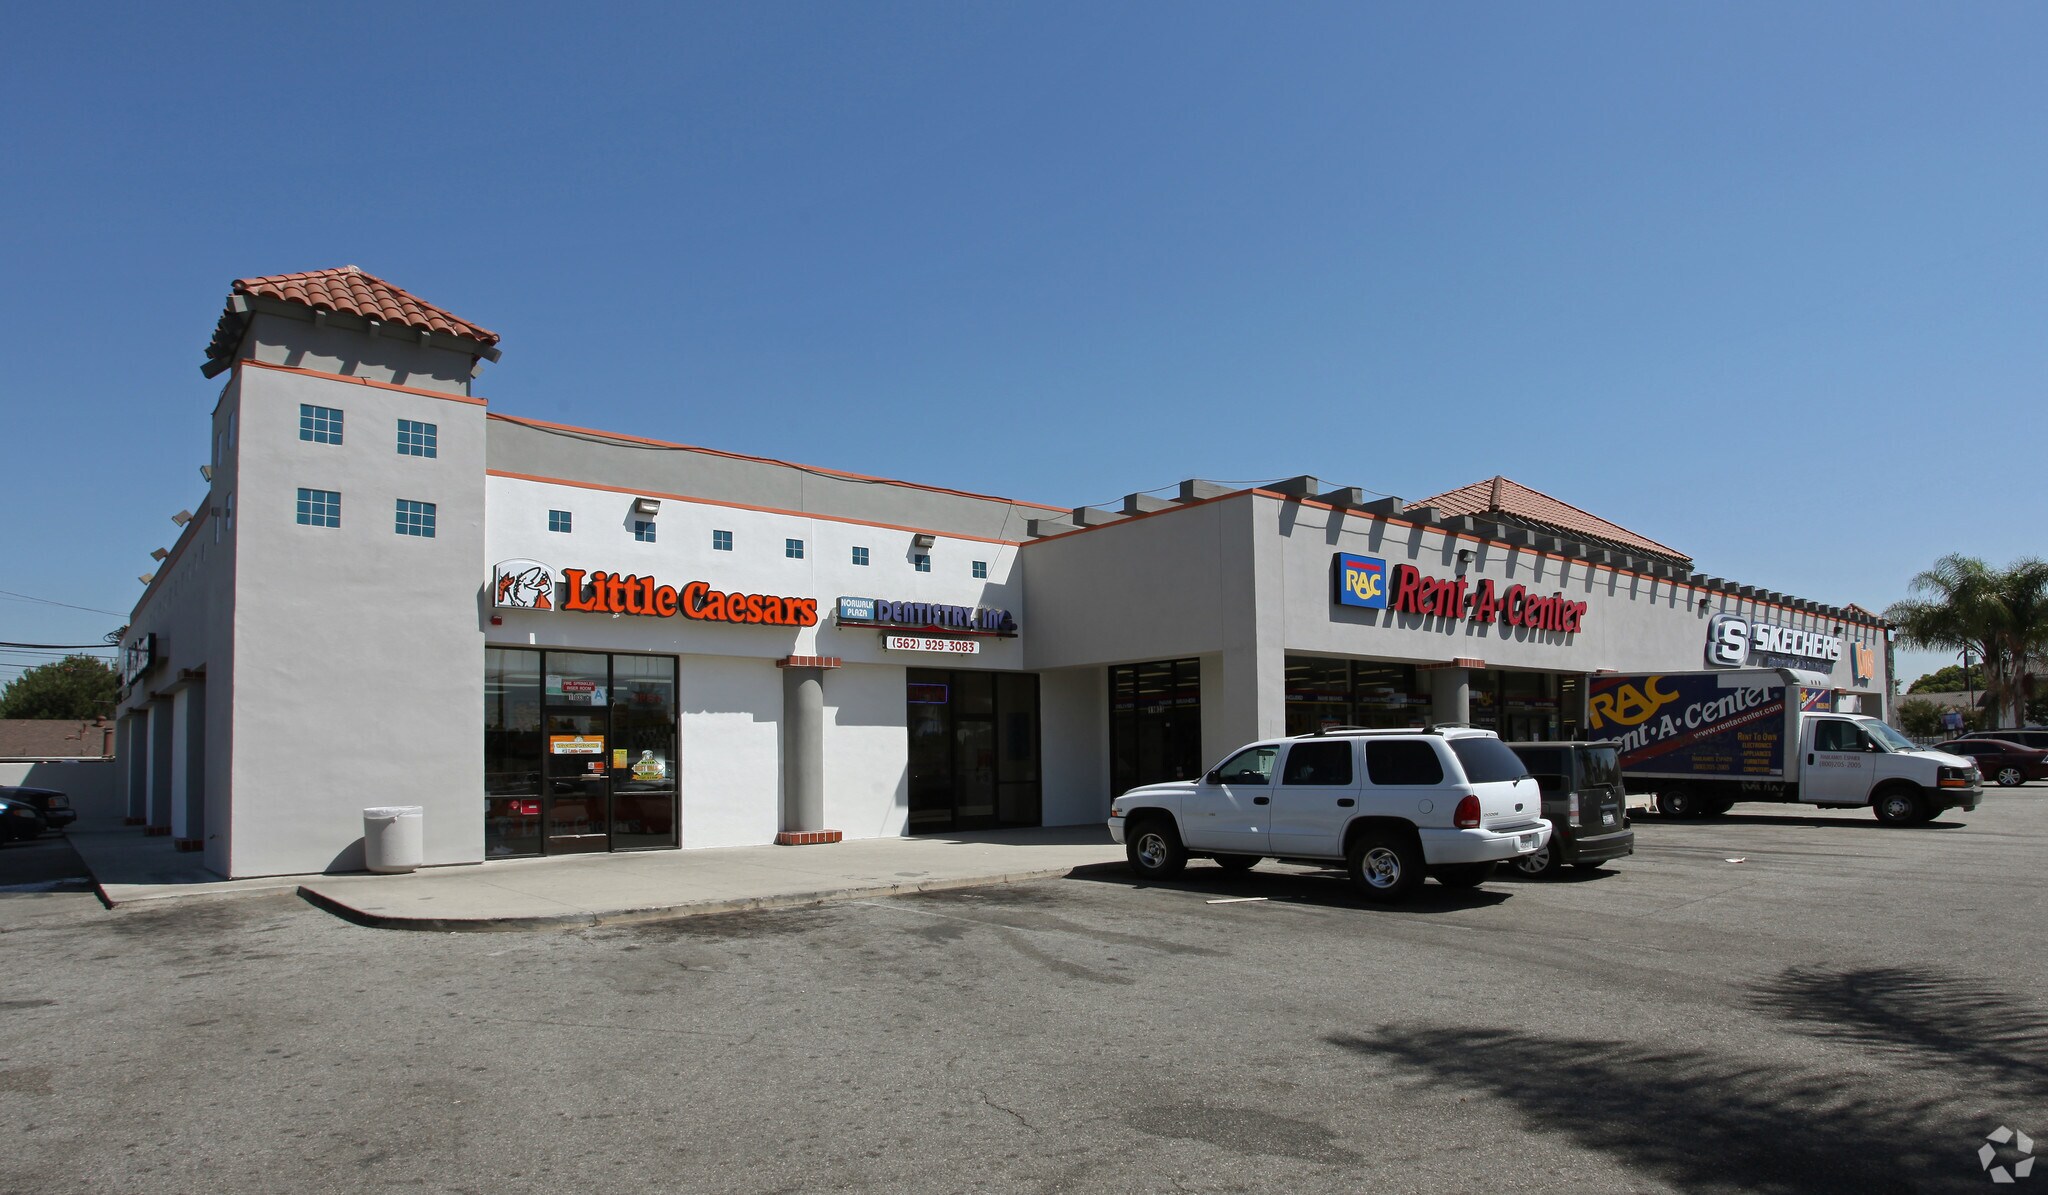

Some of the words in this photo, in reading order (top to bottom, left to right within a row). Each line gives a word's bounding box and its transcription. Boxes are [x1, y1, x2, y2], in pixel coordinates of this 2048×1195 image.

[562, 568, 677, 617] Little
[682, 581, 818, 626] Caesars
[1346, 570, 1381, 599] RAC
[841, 599, 874, 609] NORWALK
[847, 608, 867, 617] PLAZA
[892, 637, 920, 650] (562)
[925, 640, 974, 653] 929-3083
[1755, 623, 1842, 661] SKECHERS
[594, 690, 603, 699] A
[1589, 676, 1680, 730] RAC
[1693, 702, 1783, 739] www.rentacenter.com
